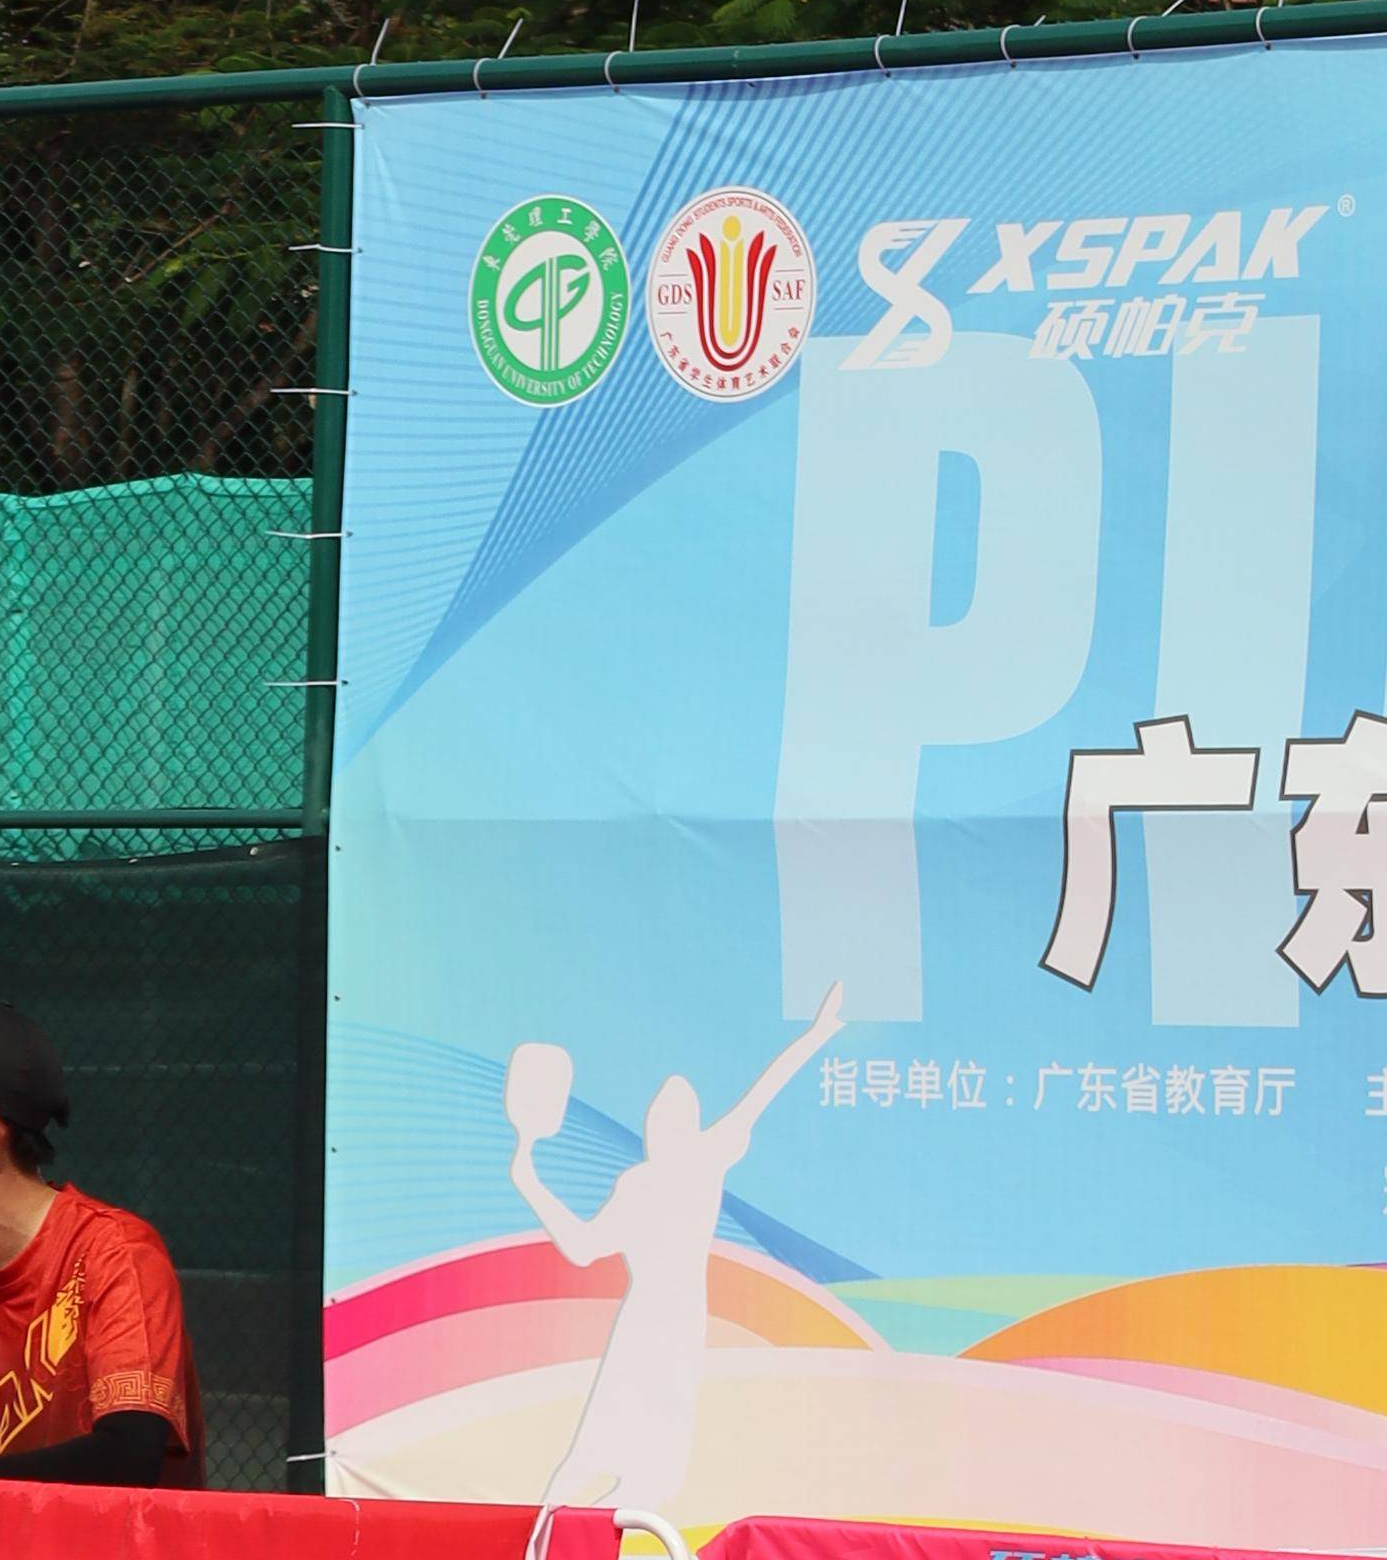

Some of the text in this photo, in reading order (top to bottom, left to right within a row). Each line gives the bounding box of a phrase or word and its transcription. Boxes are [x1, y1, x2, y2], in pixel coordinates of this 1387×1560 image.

[658, 279, 806, 305] GDS SAF
[477, 292, 623, 396] DONGGUAN UNIVERSITY OF TECHNOLOGY
[1028, 293, 1266, 361] 硕帕克
